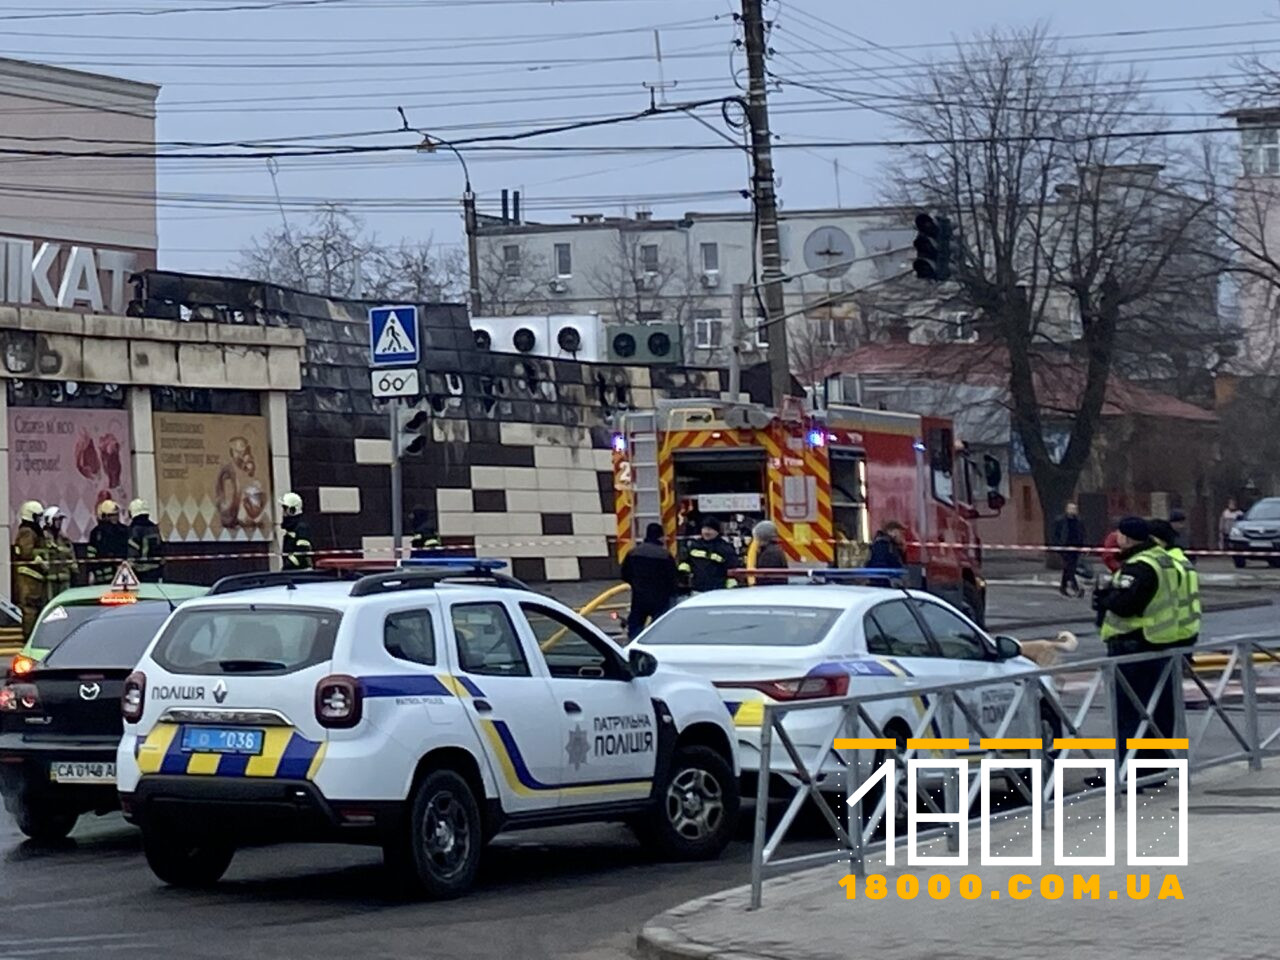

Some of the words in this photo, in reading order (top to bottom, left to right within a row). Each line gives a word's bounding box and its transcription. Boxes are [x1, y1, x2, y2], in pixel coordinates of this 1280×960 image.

[151, 685, 205, 700] ПОЛІЦІЯ
[593, 714, 652, 731] ПАТРУЛЬНА
[594, 732, 654, 756] ПОЛІЦІЯ
